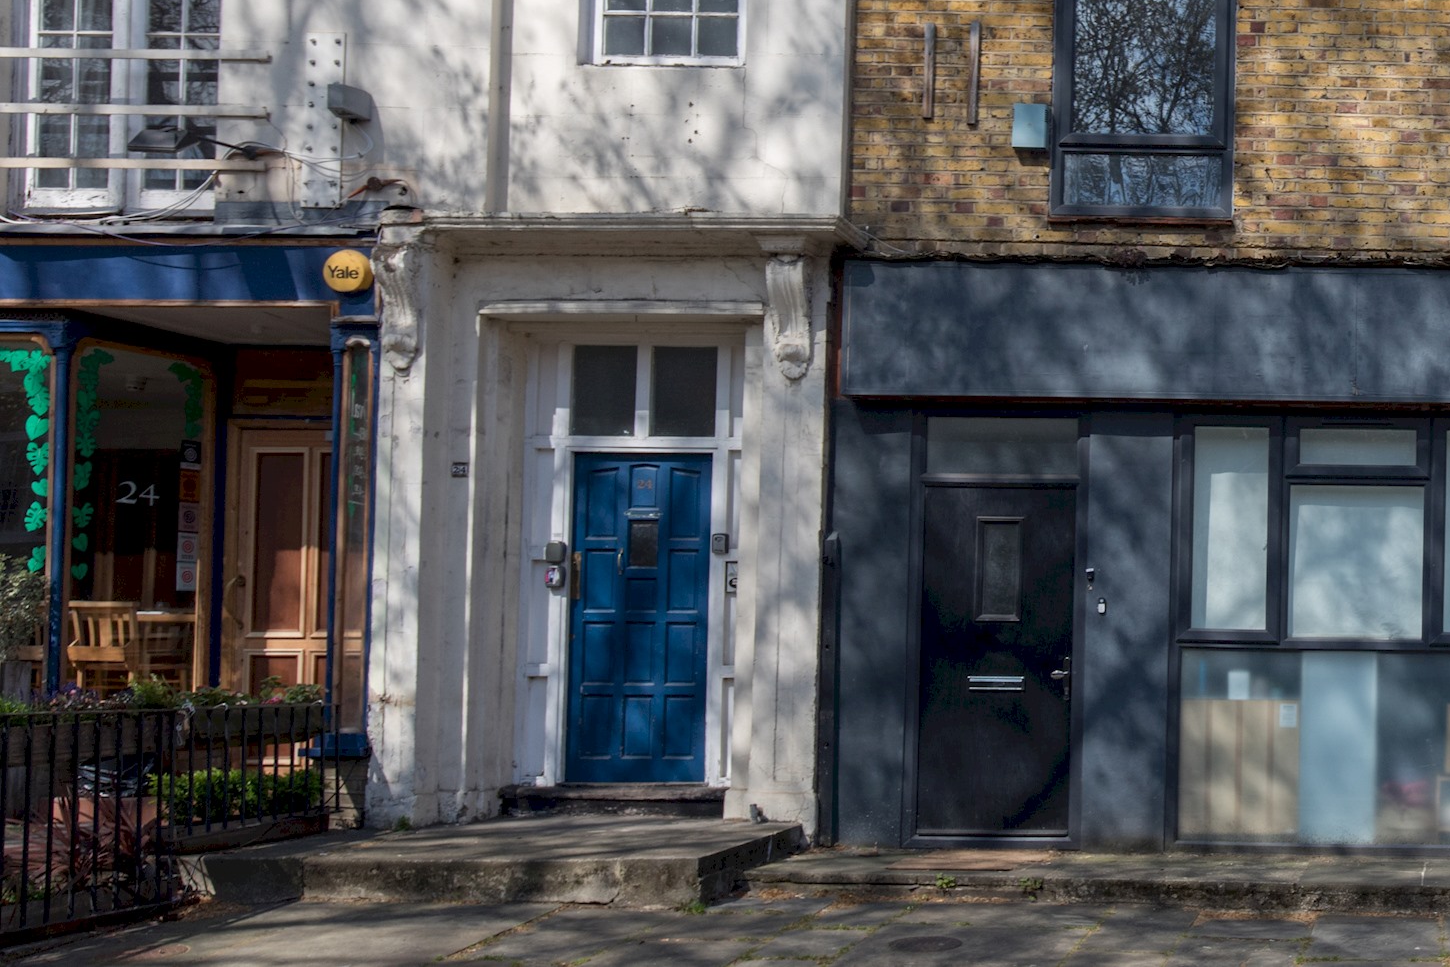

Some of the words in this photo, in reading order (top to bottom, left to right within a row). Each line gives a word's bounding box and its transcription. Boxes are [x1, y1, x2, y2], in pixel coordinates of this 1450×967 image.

[327, 265, 359, 279] Yale
[637, 478, 653, 491] 24
[115, 480, 160, 507] 24
